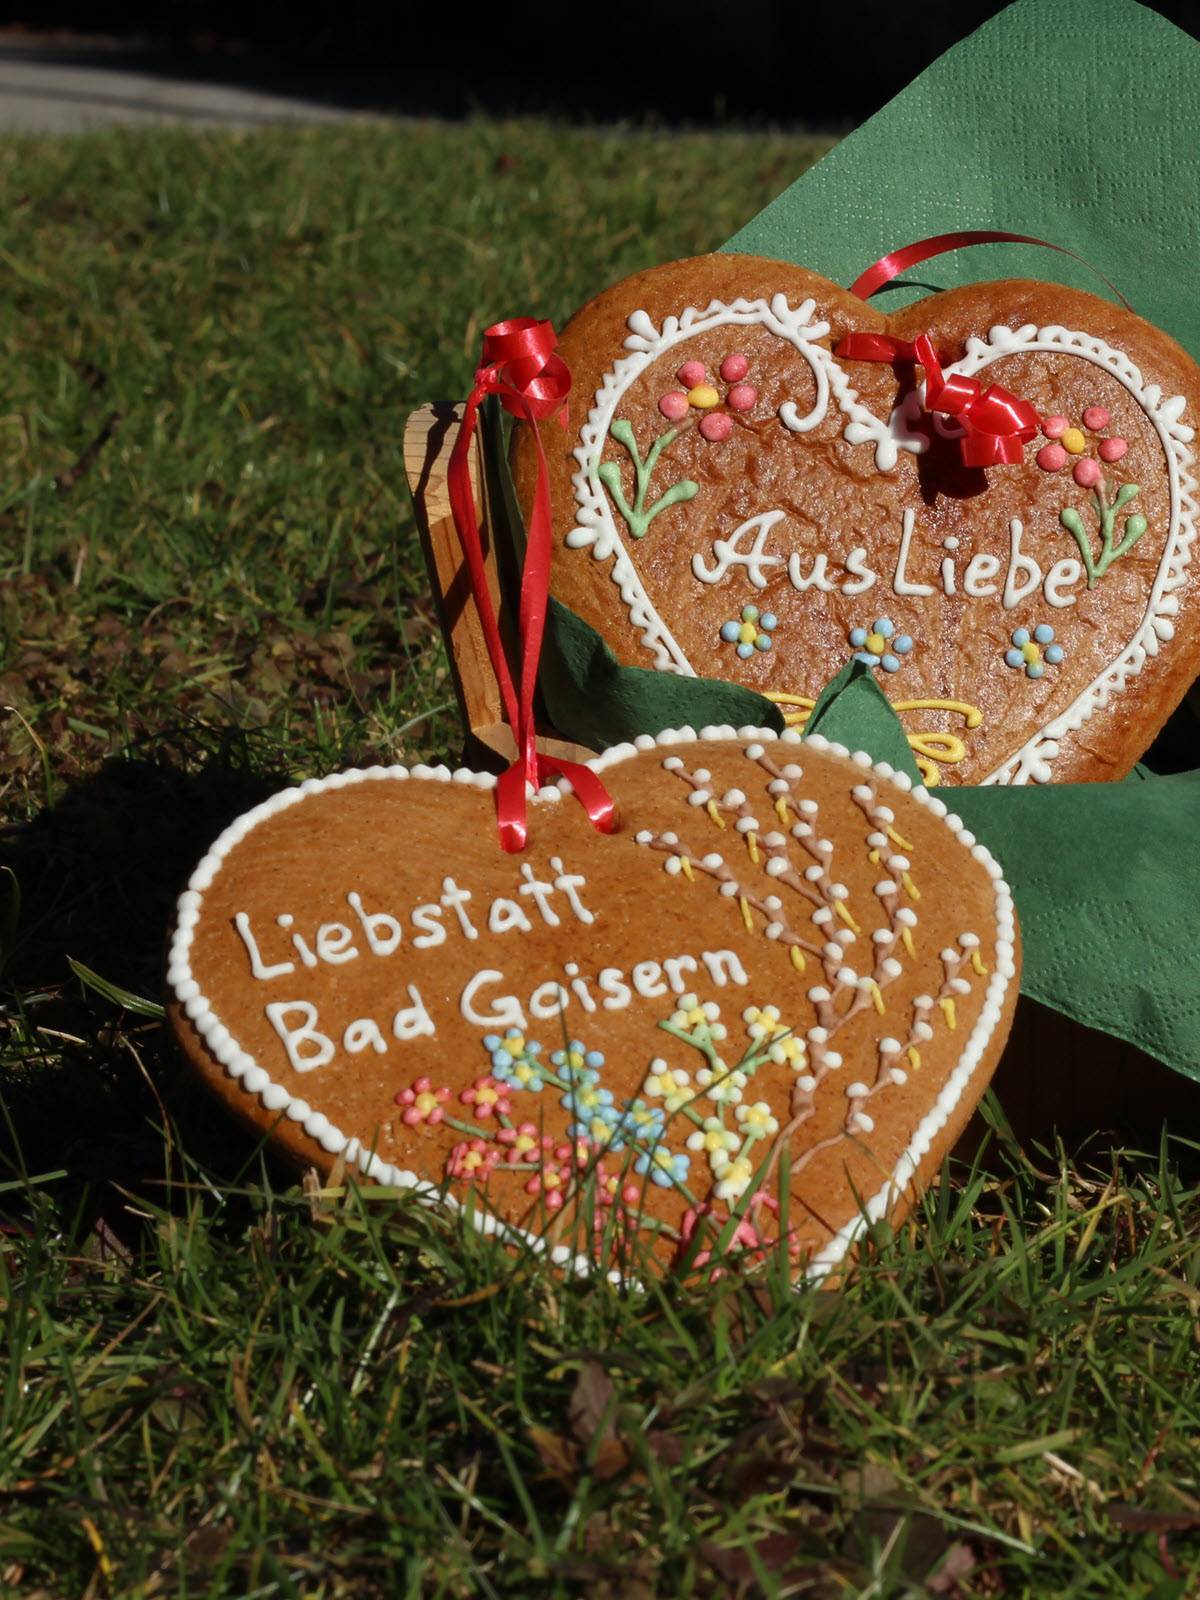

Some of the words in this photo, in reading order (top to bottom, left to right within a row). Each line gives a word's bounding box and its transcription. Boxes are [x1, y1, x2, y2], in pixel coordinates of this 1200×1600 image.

[692, 510, 878, 597] Aus
[893, 508, 1082, 609] Liebe
[235, 856, 595, 980] Liebstatt
[265, 983, 436, 1073] Bad
[460, 949, 749, 1030] Goisern
